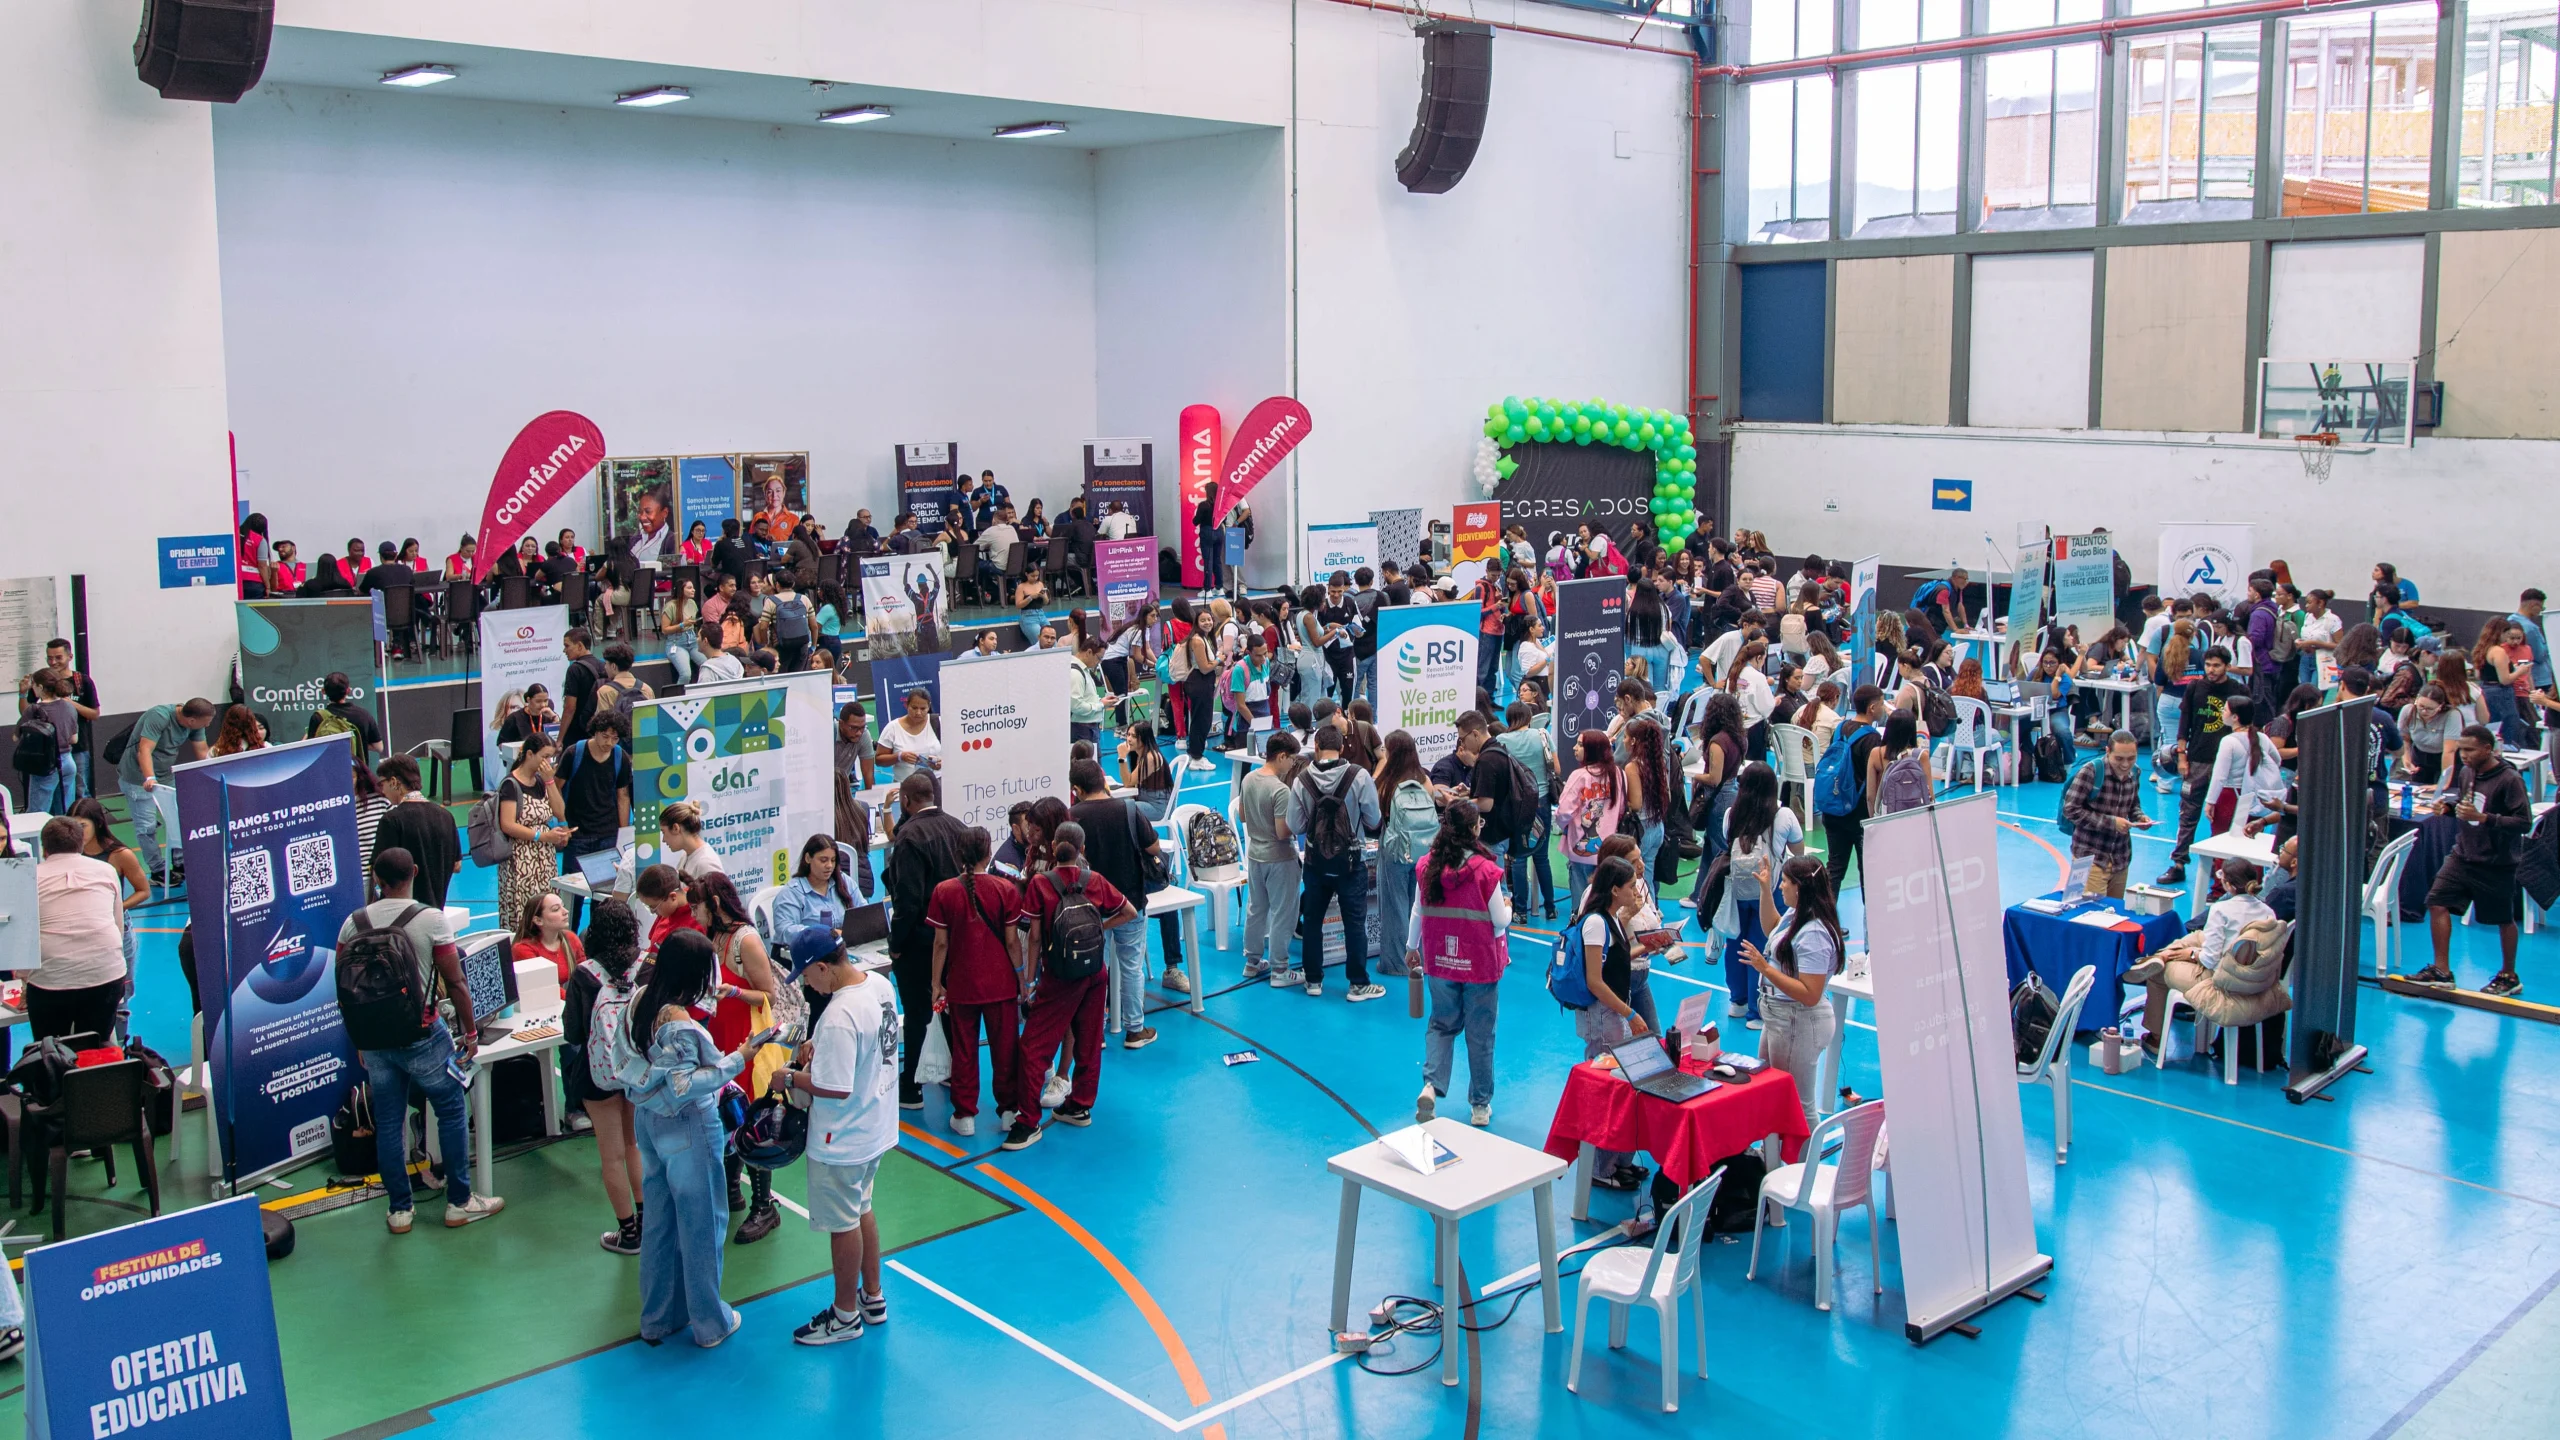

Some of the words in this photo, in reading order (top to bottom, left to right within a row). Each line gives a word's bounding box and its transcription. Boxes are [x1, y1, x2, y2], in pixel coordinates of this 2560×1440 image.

[1230, 414, 1298, 484] comfama
[496, 434, 586, 525] comfama
[915, 479, 953, 487] conectamos
[910, 502, 939, 510] OFICINA
[1502, 497, 1649, 518] EGRESADOS
[1456, 530, 1497, 543] ¡BIENVENIDOS!
[2072, 536, 2108, 548] TALENTOS
[170, 548, 196, 559] OFICINA
[197, 546, 226, 557] PÚBLICA
[1324, 555, 1365, 566] talento
[2071, 548, 2092, 558] Grupo
[2092, 546, 2107, 556] Bios
[179, 560, 189, 568] DE
[190, 558, 218, 568] EMPLEO
[2062, 579, 2070, 588] TE
[2070, 578, 2086, 586] HACE
[2087, 576, 2109, 586] CRECER
[1564, 630, 1587, 639] Servicios
[1594, 626, 1620, 635] Protección
[1427, 640, 1464, 666] RSI
[526, 666, 548, 674] empresa!
[1400, 688, 1427, 706] We
[1432, 688, 1457, 704] are
[960, 704, 1016, 720] Securitas
[1402, 706, 1457, 728] Hiring
[961, 717, 1028, 734] Technology
[712, 766, 760, 792] dar
[712, 790, 733, 800] ayuda
[734, 784, 760, 796] temporal
[963, 783, 996, 802] The
[1002, 775, 1052, 796] future
[188, 813, 270, 841] ACELRAMOS
[272, 808, 288, 822] TU
[292, 794, 351, 816] PROGRESO
[964, 807, 980, 825] of
[241, 830, 250, 838] EL
[252, 828, 261, 836] DE
[264, 823, 284, 832] TODO
[286, 820, 296, 828] UN
[298, 816, 315, 824] PAÍS
[726, 826, 774, 843] interesa
[290, 833, 312, 842] ESCANEA
[730, 837, 762, 856] perfil
[738, 870, 744, 878] el
[744, 867, 764, 877] código
[742, 876, 764, 886] cámara
[300, 899, 330, 911] LABORALES
[303, 894, 326, 904] OFERTAS
[236, 911, 262, 922] VACANTES
[269, 934, 306, 956] AKT
[293, 1013, 302, 1021] un
[302, 1006, 322, 1018] futuro
[256, 1034, 266, 1044] LA
[267, 1020, 310, 1040] INNOVACIÓN
[310, 1016, 316, 1024] Y
[250, 1046, 263, 1056] son
[264, 1038, 288, 1051] nuestro
[290, 1031, 310, 1044] motor
[310, 1026, 320, 1035] de
[272, 1064, 298, 1078] Ingresa
[306, 1052, 332, 1066] nuestro
[270, 1075, 298, 1090] PORTAL
[300, 1070, 309, 1080] DE
[310, 1061, 338, 1076] EMPLEO
[272, 1094, 280, 1104] Y
[282, 1072, 338, 1100] POSTÚLATE
[297, 1130, 326, 1148] talento
[100, 1249, 176, 1281] FESTIVAL
[180, 1242, 202, 1258] DE
[80, 1252, 222, 1301] OPORTUNIDADES
[110, 1330, 218, 1392] OFERTA
[90, 1362, 248, 1440] EDUCATIVA
